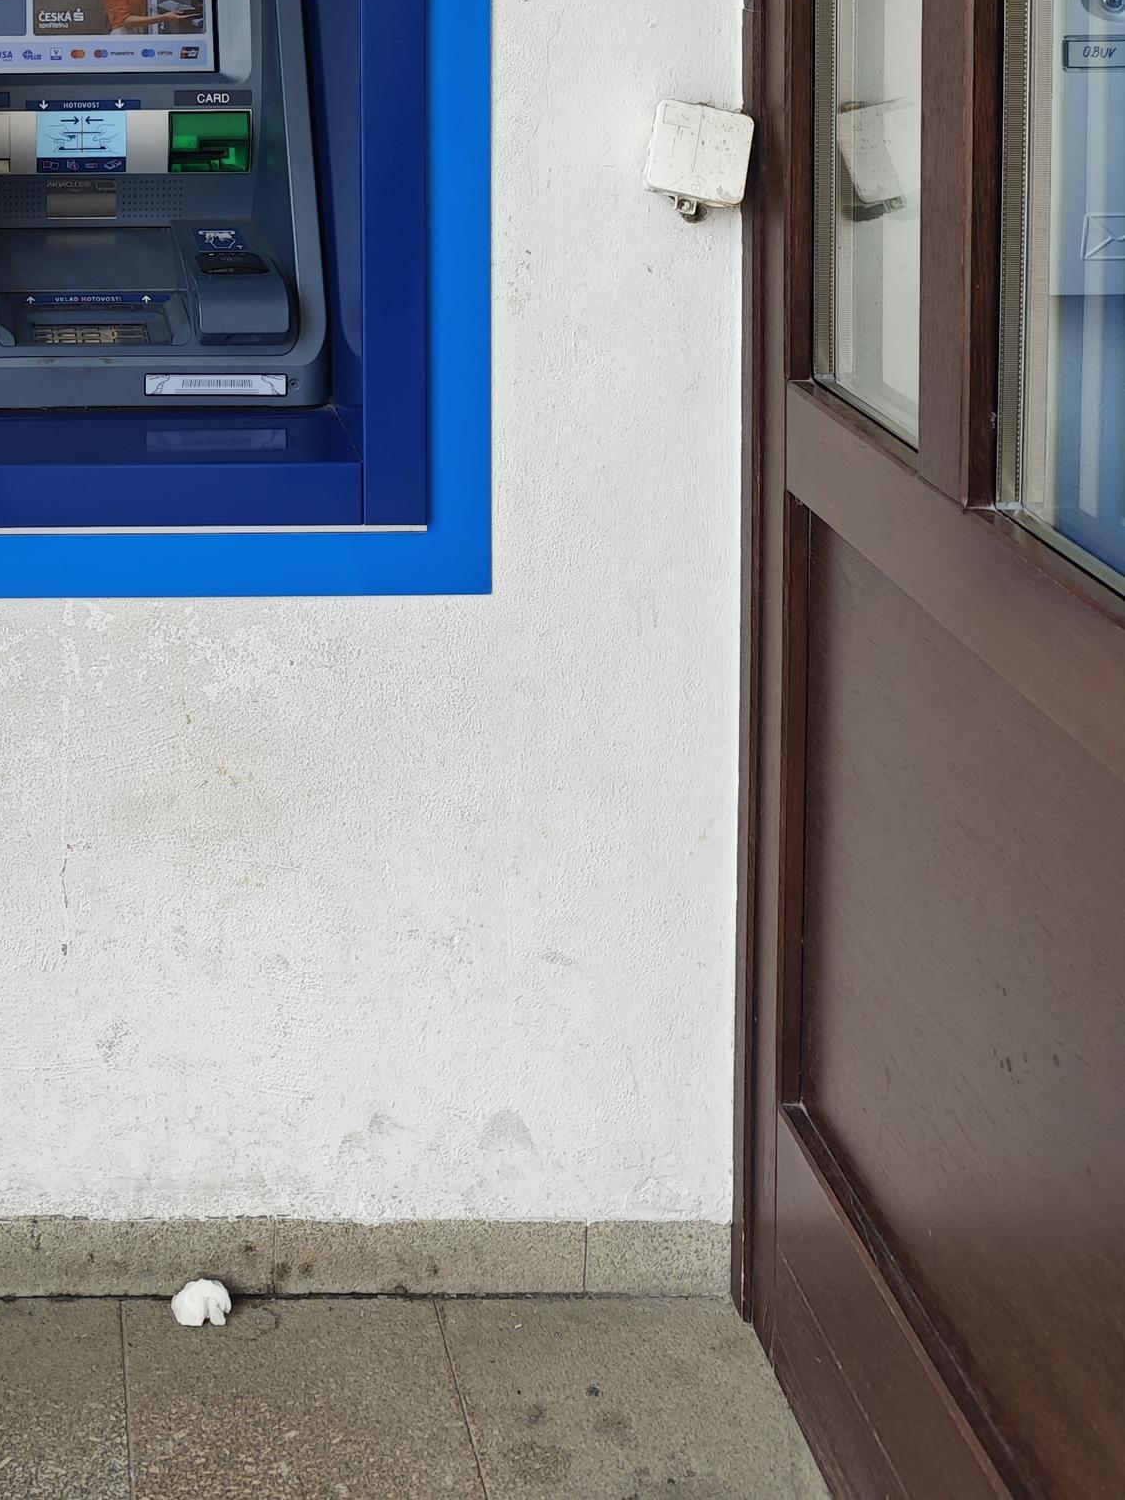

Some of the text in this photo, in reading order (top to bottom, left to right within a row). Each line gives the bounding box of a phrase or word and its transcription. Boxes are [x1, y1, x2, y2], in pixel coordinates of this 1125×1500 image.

[38, 10, 72, 22] ČESKÁ
[1082, 45, 1117, 59] OBUV
[196, 93, 230, 104] CARD
